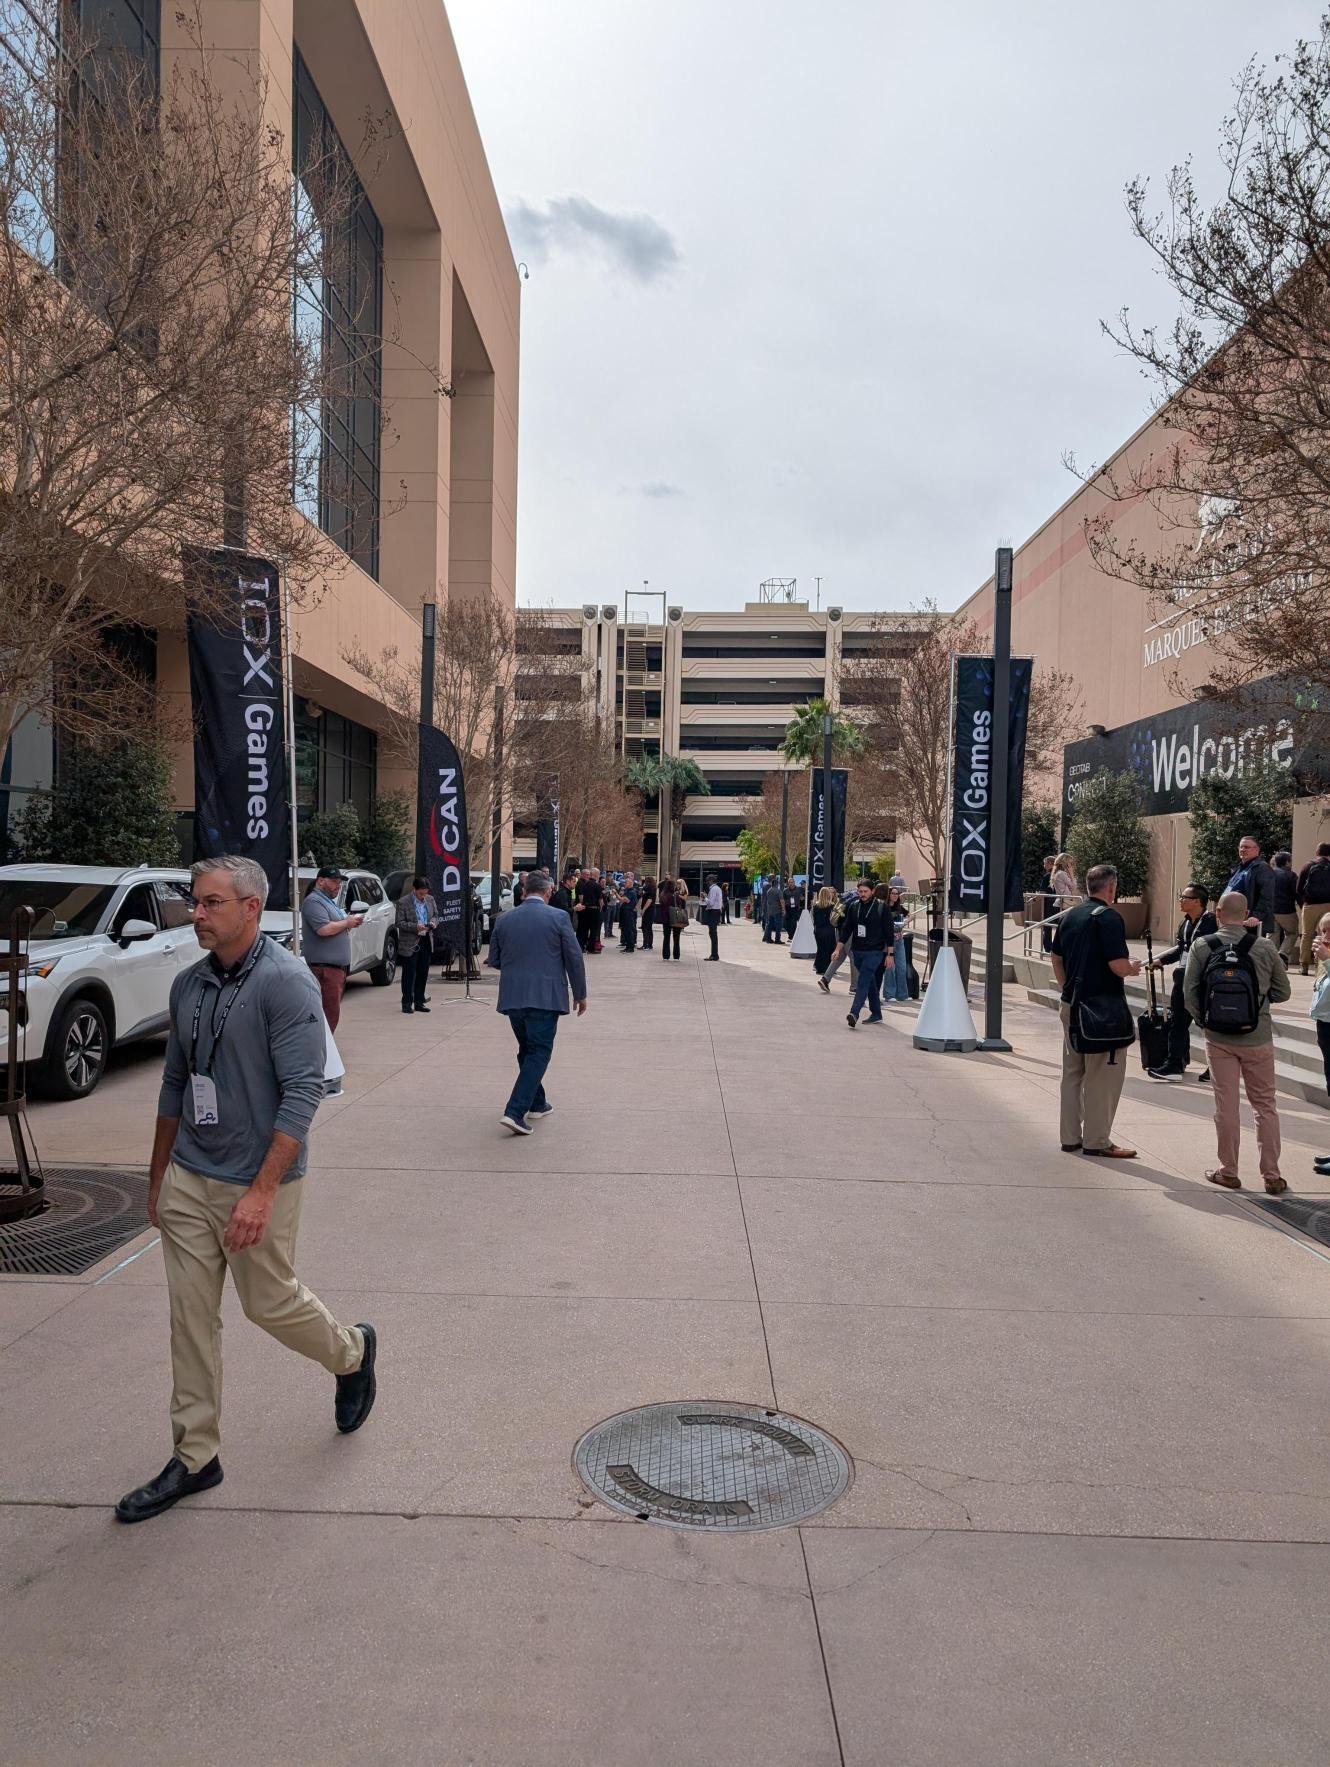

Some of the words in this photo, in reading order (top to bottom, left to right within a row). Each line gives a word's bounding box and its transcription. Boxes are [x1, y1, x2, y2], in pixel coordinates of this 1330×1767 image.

[244, 703, 274, 839] Games
[964, 709, 992, 809] Games
[960, 818, 987, 900] IOX
[683, 1416, 742, 1427] CLARK
[754, 1423, 811, 1456] COUNTY
[614, 1469, 661, 1502] STORM
[670, 1499, 737, 1516] DRAIN
